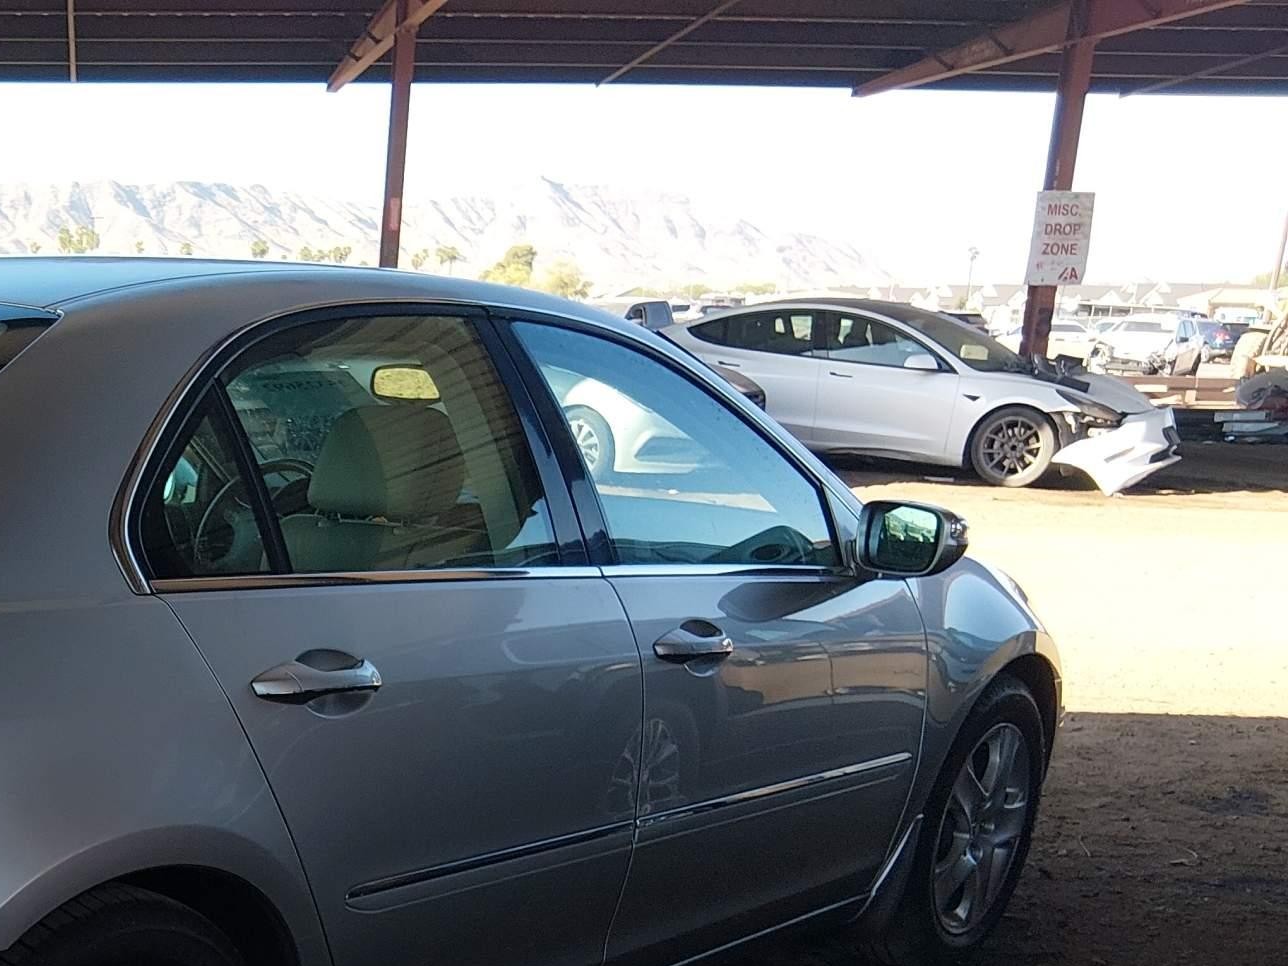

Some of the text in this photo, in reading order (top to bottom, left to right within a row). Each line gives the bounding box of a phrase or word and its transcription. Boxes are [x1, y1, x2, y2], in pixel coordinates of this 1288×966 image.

[1047, 203, 1082, 217] MISC.
[1044, 223, 1081, 236] DROP
[1041, 242, 1078, 256] ZONE
